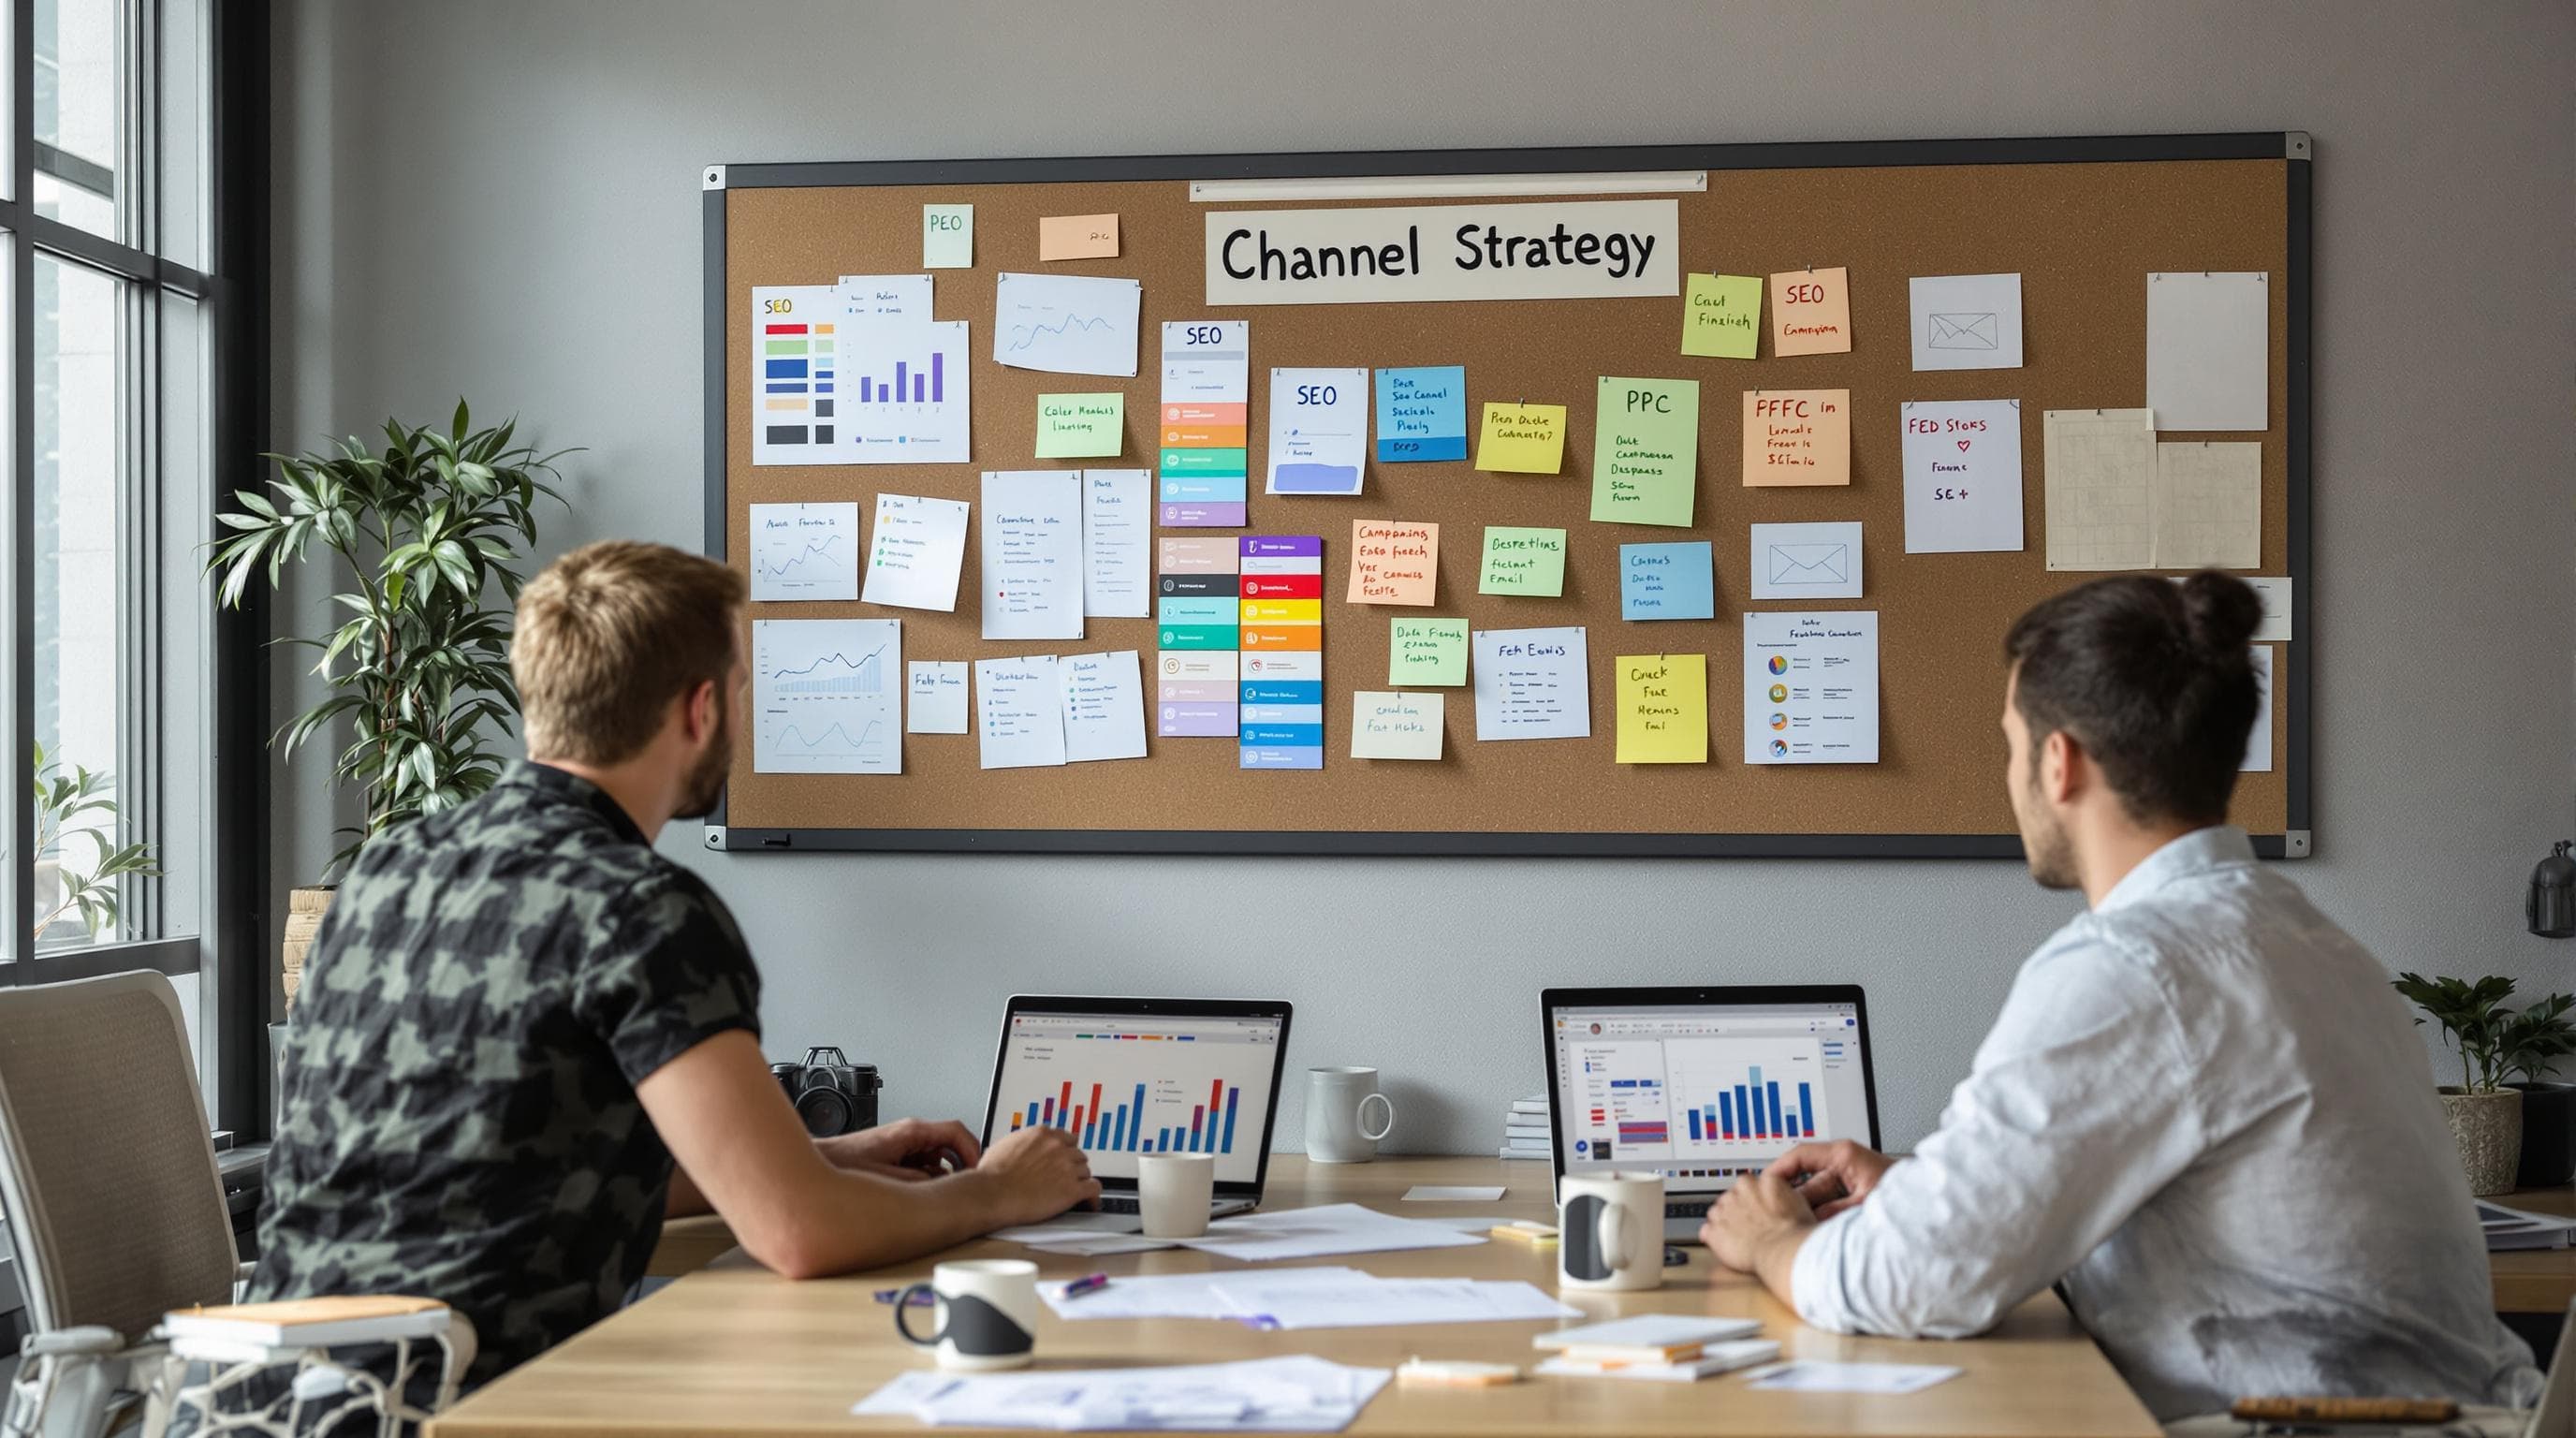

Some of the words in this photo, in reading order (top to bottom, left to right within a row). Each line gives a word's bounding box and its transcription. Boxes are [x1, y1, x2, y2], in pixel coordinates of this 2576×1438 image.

[930, 214, 962, 232] PEO
[1222, 226, 1421, 281] Channel
[1454, 223, 1656, 279] Strategy
[1785, 284, 1824, 304] SEO
[764, 299, 793, 315] SEO
[1186, 327, 1222, 345] SEO
[1296, 385, 1338, 406] SEO
[1626, 390, 1671, 414] PPC
[1909, 418, 1939, 433] FED
[1489, 573, 1523, 583] Email
